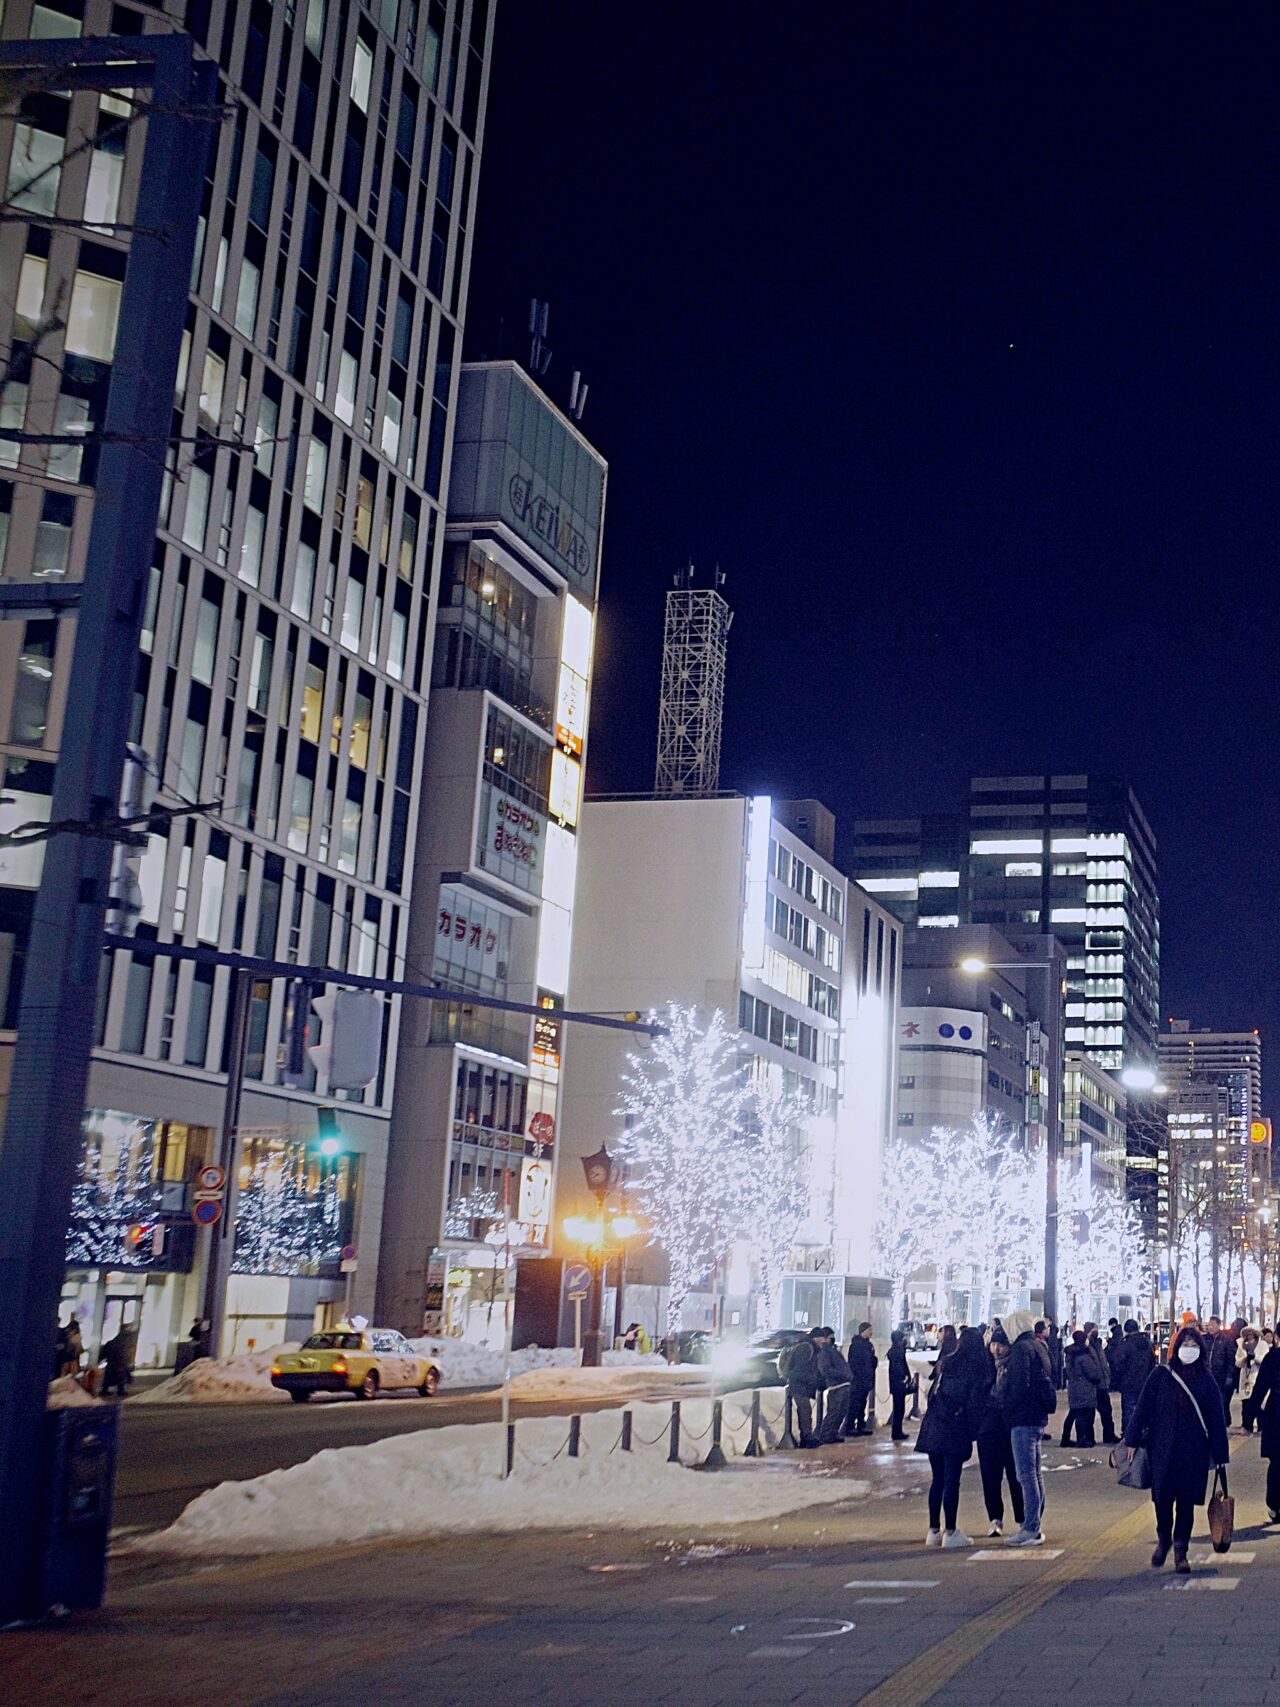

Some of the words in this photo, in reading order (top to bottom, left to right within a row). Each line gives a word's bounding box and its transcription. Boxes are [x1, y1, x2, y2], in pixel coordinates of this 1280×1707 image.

[504, 800, 534, 832] カラオケ
[437, 910, 497, 955] カラオケ
